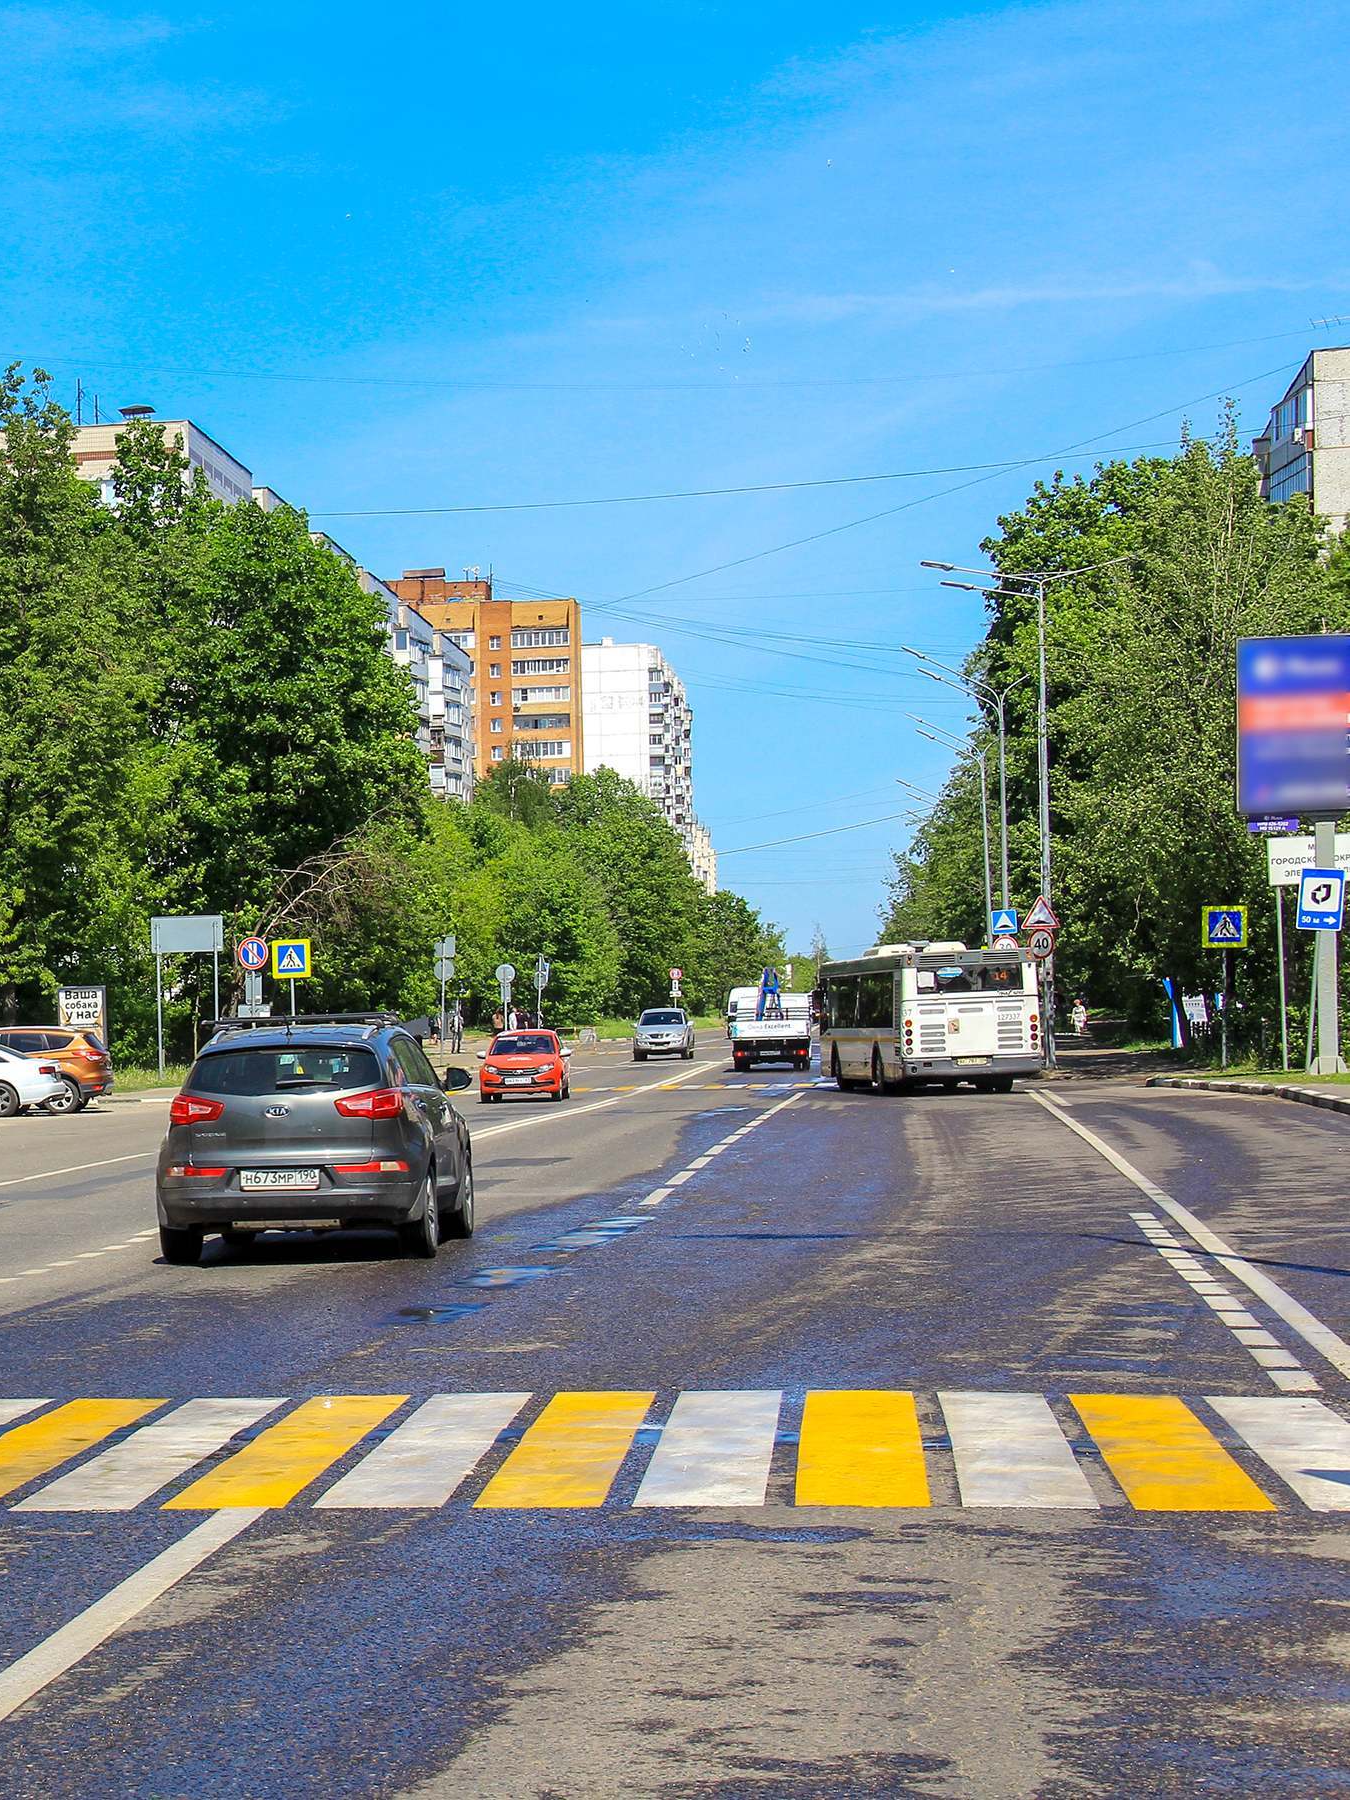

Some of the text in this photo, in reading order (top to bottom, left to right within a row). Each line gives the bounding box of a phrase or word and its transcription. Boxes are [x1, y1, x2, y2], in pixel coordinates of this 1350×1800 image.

[1301, 915, 1312, 923] 50
[1034, 937, 1049, 950] 40
[64, 990, 98, 1000] Ваша
[65, 1001, 98, 1010] собака
[65, 1010, 99, 1022] у нас
[997, 1012, 1021, 1020] 127337
[269, 1107, 287, 1116] KIA
[245, 1172, 294, 1185] Н673МР
